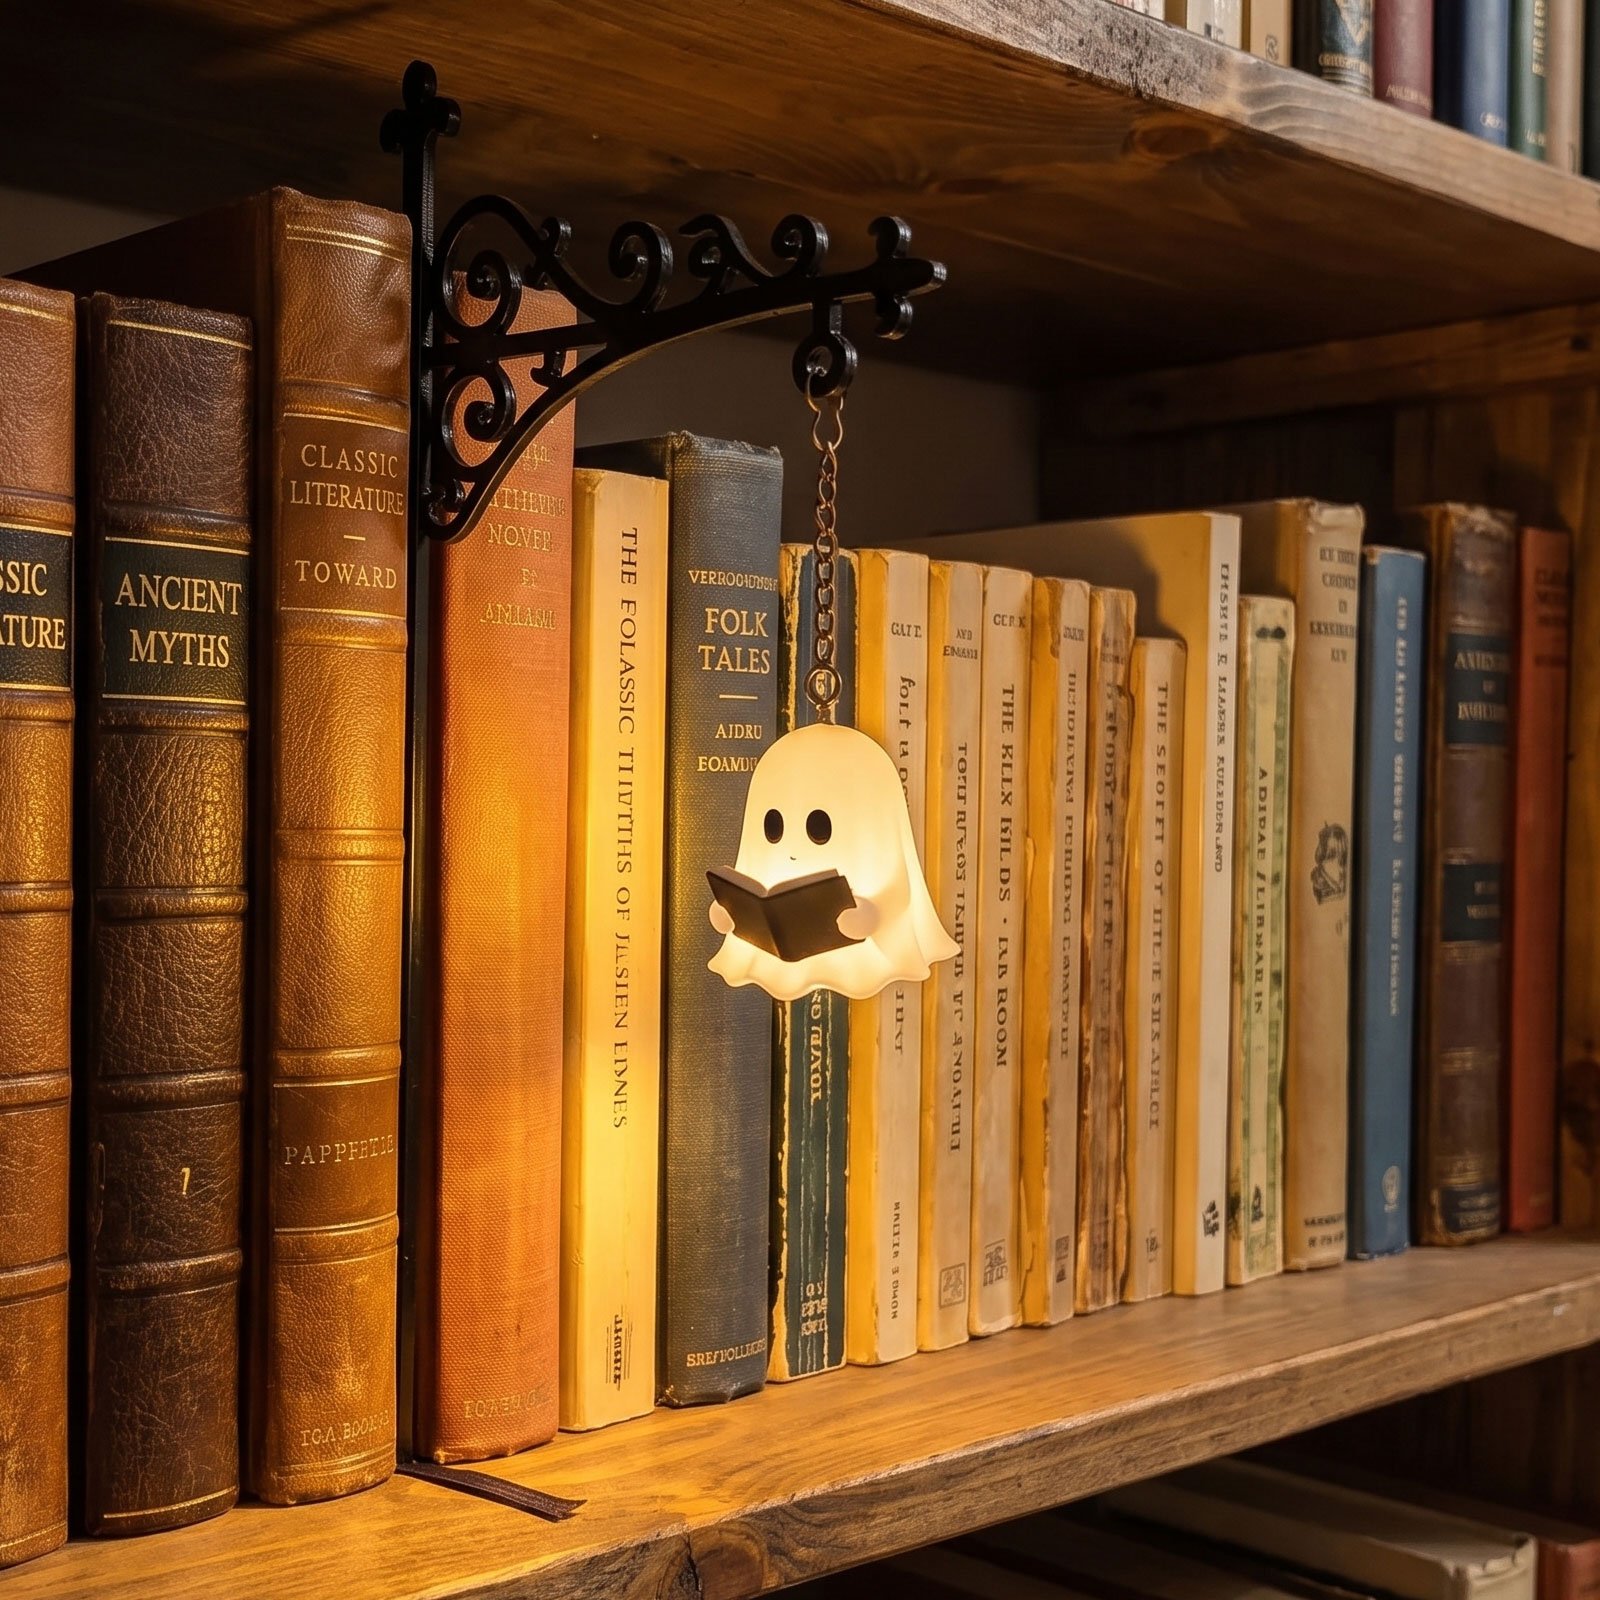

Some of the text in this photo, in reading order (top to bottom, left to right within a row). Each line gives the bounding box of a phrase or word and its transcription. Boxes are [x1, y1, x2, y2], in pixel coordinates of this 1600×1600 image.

[301, 443, 399, 479] CLASSIC
[289, 479, 404, 516] LITERATURE
[294, 559, 398, 590] TOWARD
[620, 527, 638, 585] THE
[0, 560, 48, 597] SIC
[114, 573, 242, 616] ANCIENT
[0, 613, 66, 650] TURE
[704, 607, 769, 638] FOLK
[129, 629, 230, 668] MYTHS
[619, 599, 637, 735] FOLASSIC
[698, 645, 771, 675] TALES
[1001, 683, 1015, 734] THE
[1156, 681, 1169, 735] THE
[617, 887, 631, 921] OF
